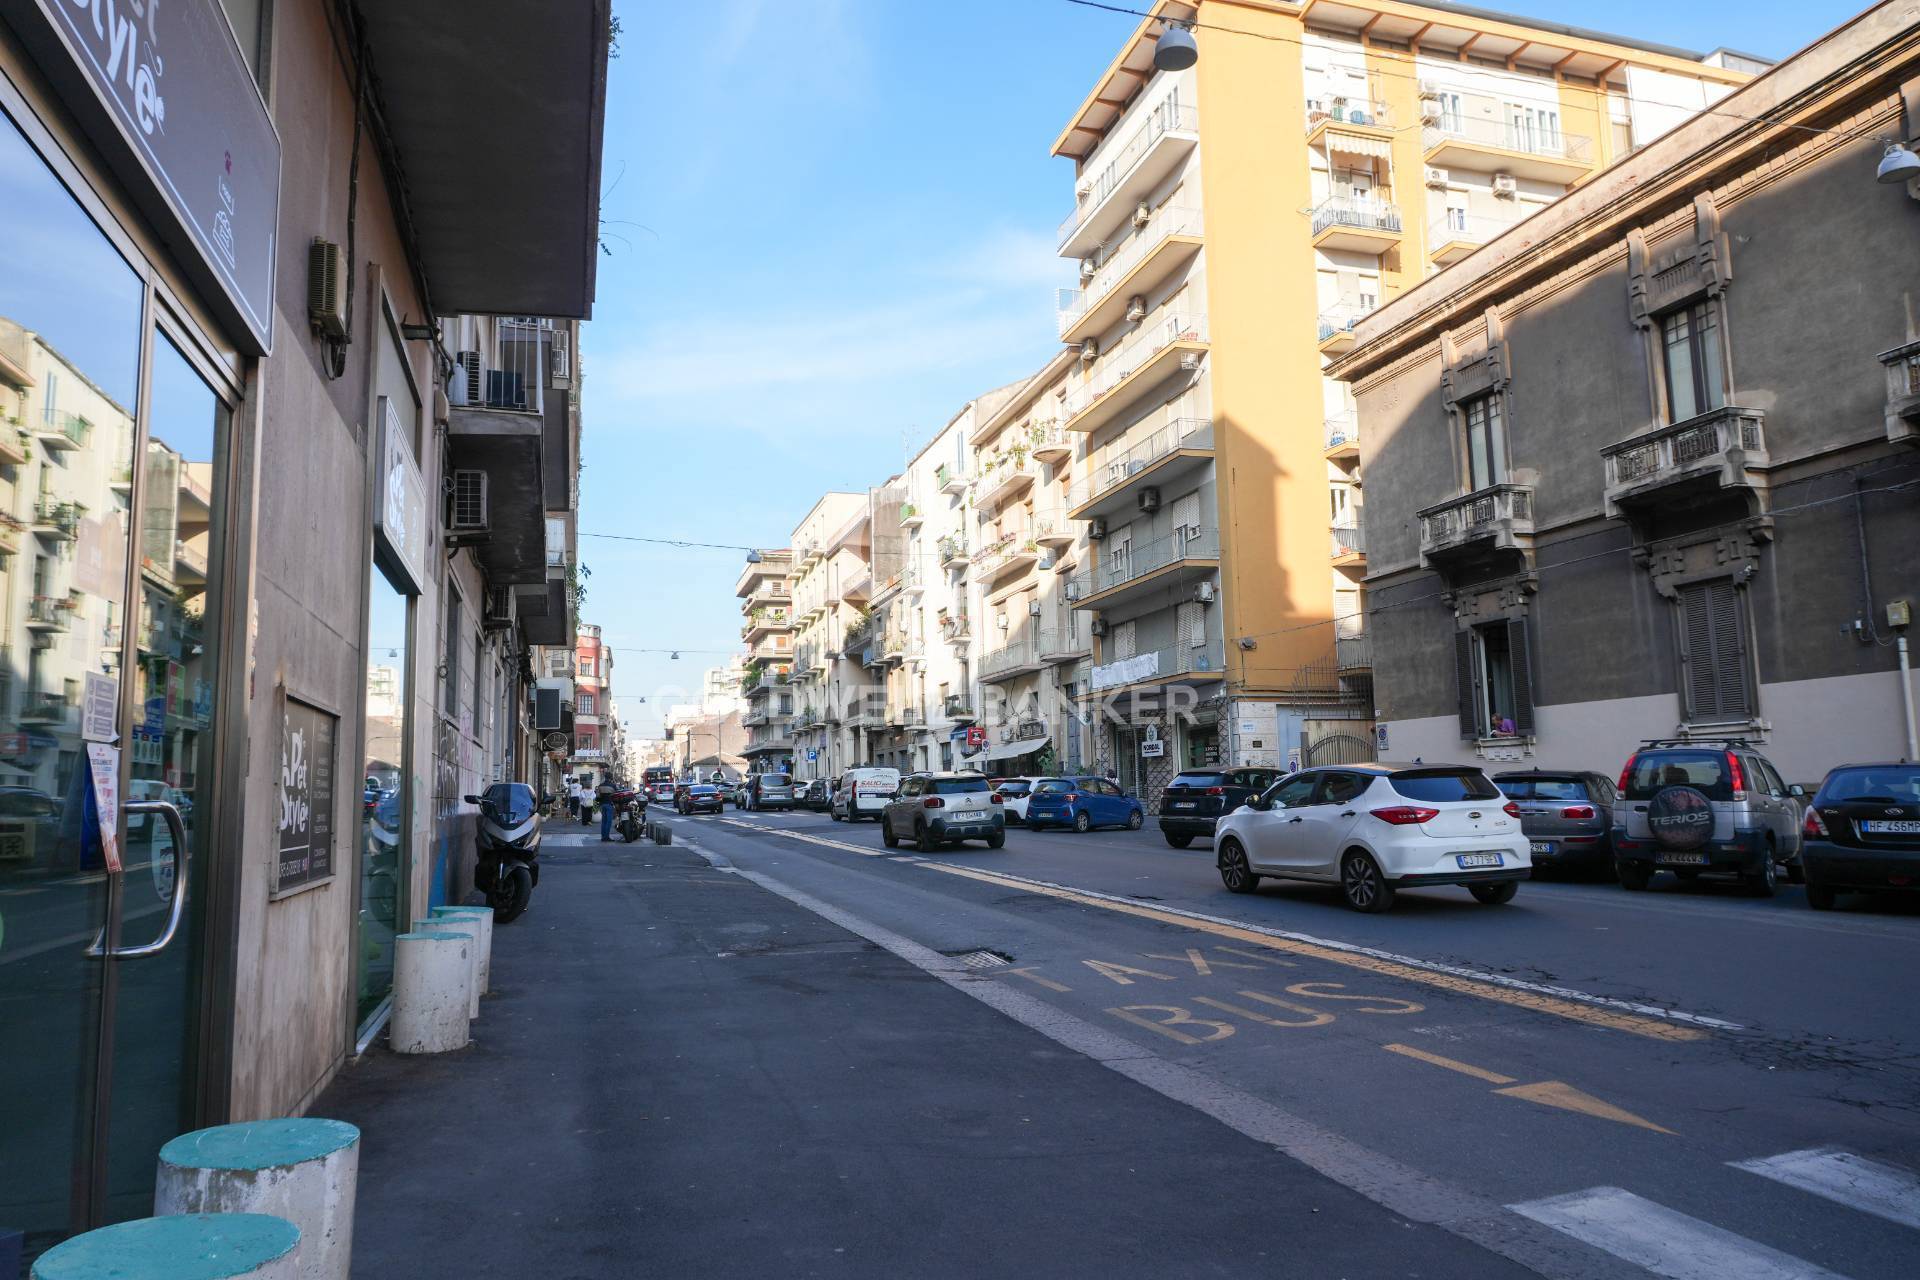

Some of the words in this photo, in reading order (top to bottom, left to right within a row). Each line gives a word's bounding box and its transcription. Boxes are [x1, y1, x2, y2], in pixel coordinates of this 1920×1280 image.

[290, 728, 308, 790] Pet
[1650, 811, 1710, 826] TERIOS
[995, 946, 1296, 992] TAXI
[1104, 982, 1425, 1044] BUS
